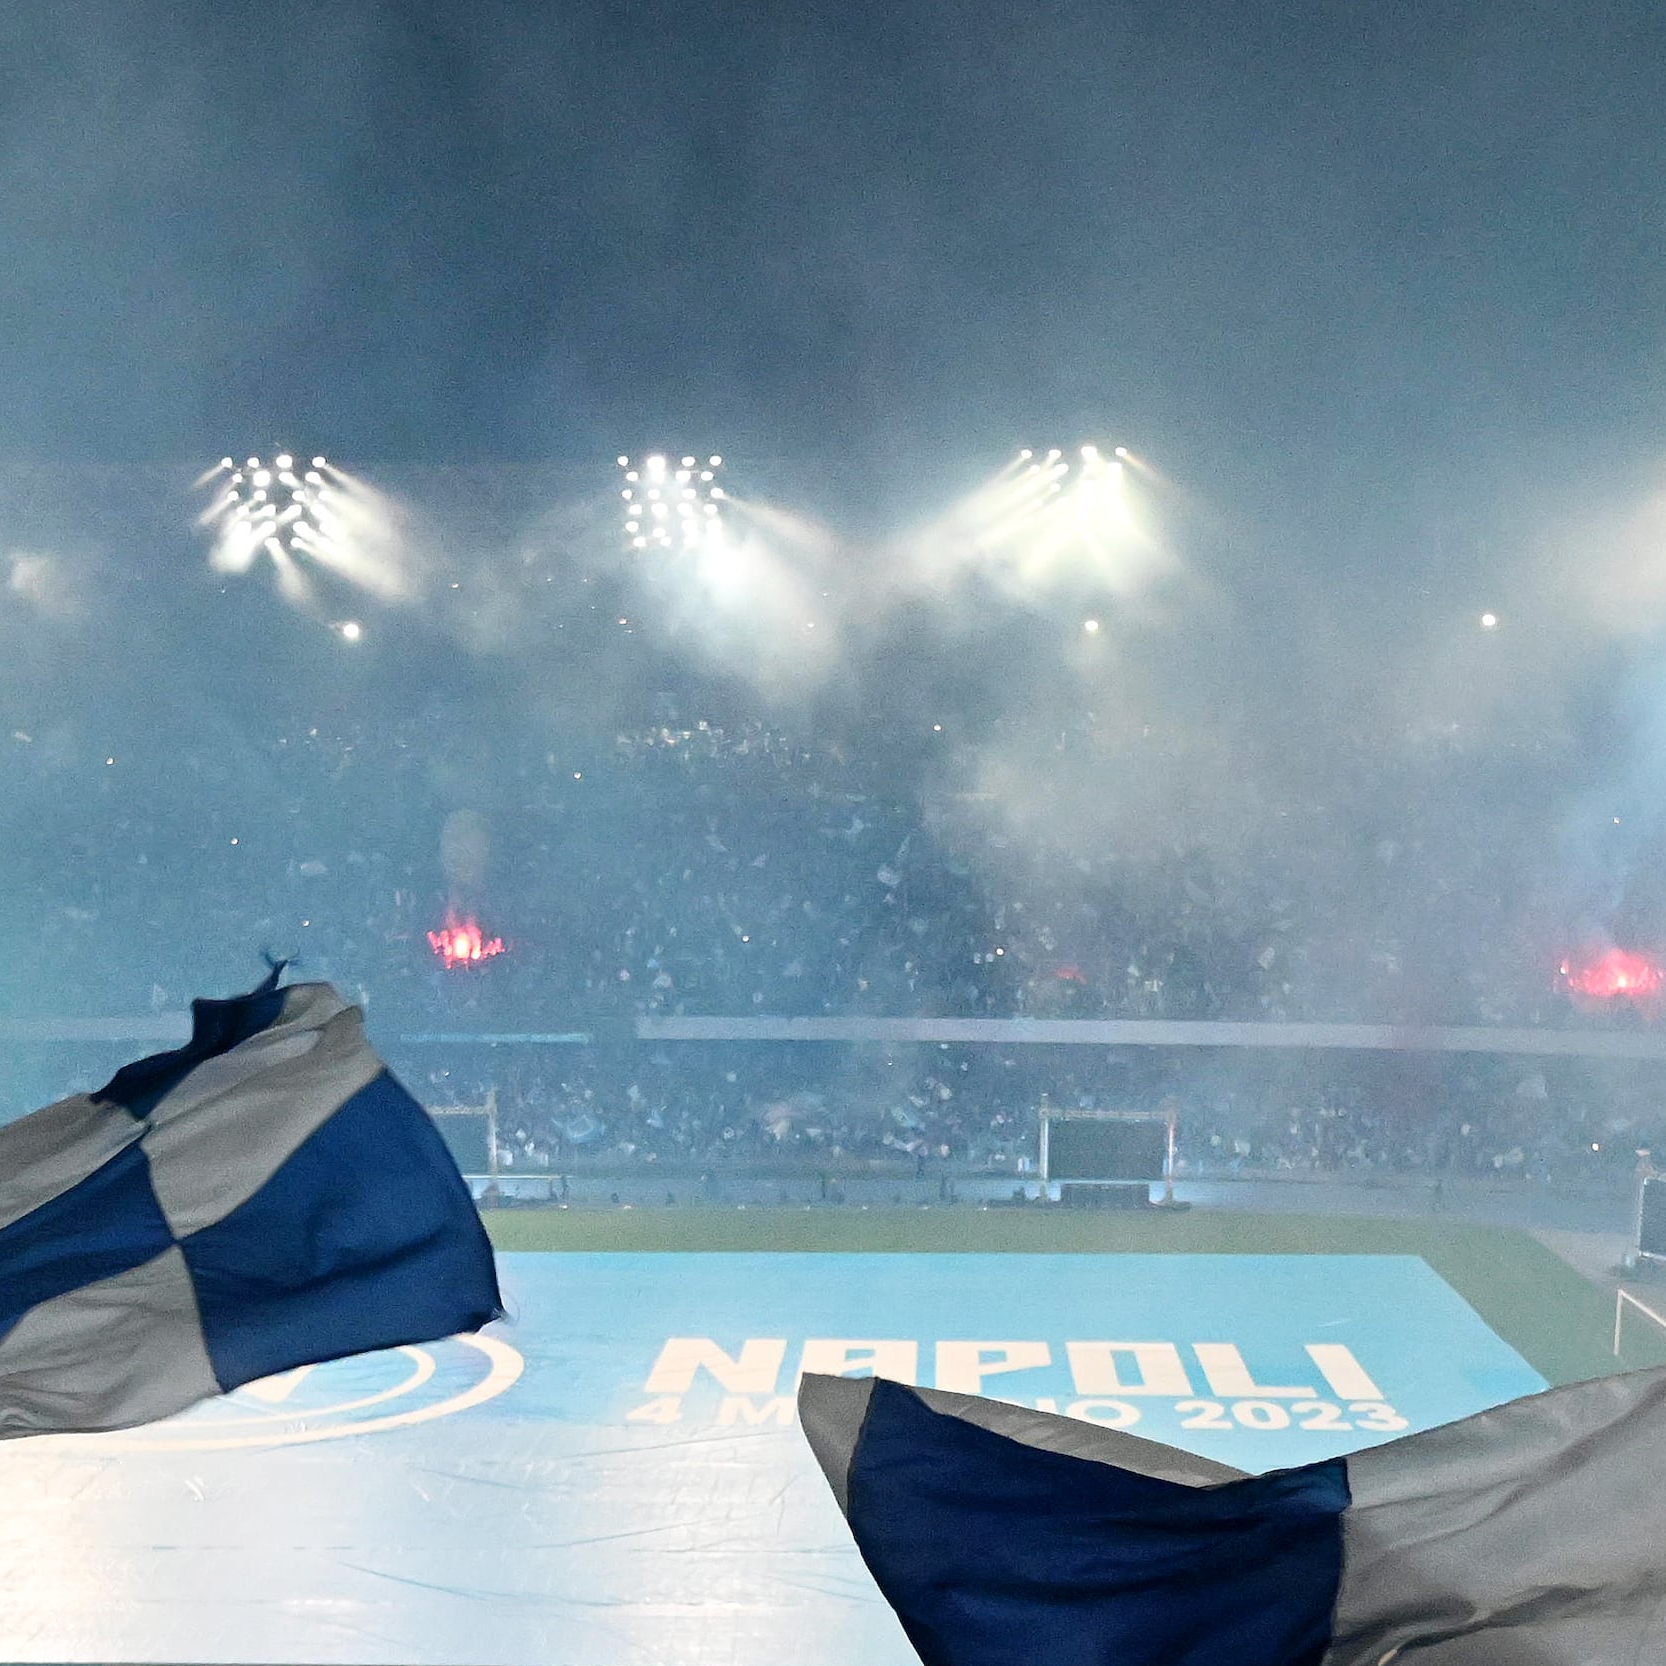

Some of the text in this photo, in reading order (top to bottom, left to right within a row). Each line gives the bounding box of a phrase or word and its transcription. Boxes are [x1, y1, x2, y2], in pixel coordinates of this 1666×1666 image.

[644, 1337, 1384, 1400] NAPOLI
[626, 1396, 681, 1425] 4
[1173, 1399, 1410, 1431] 2023
